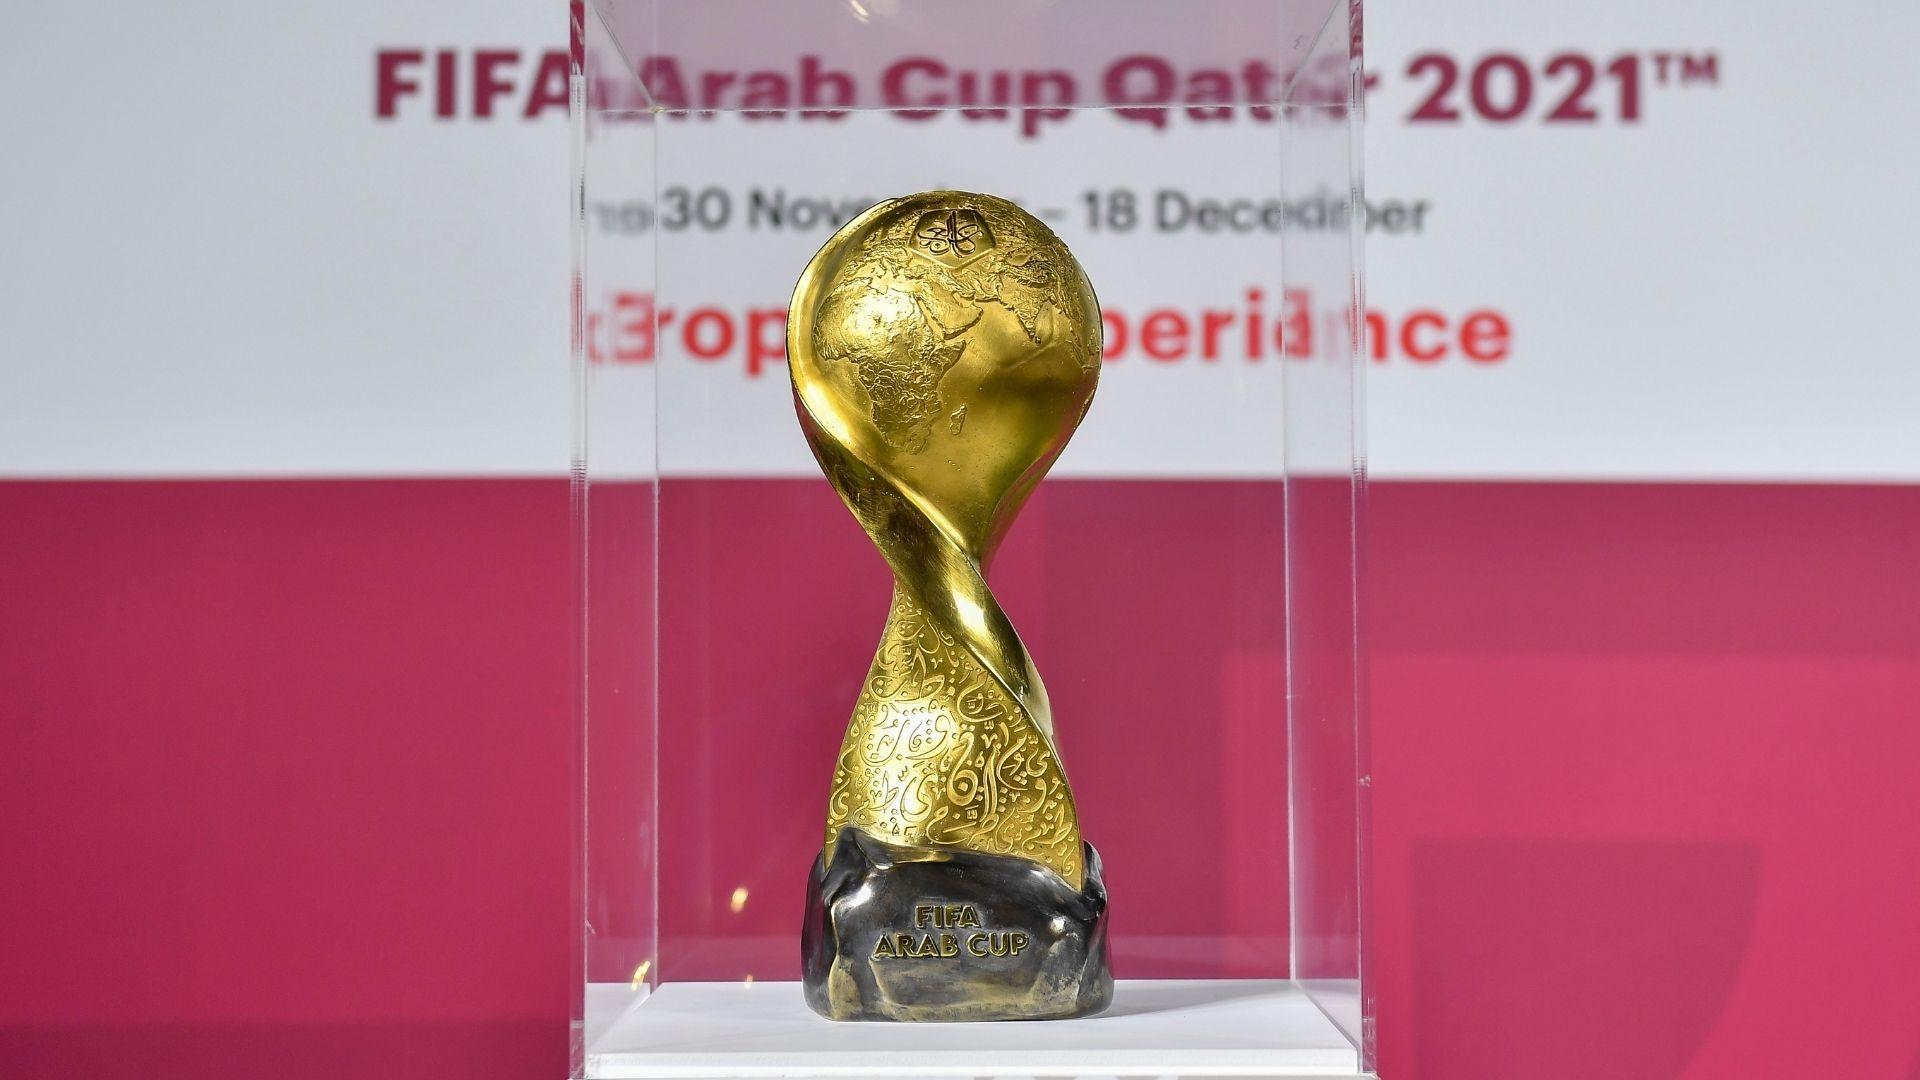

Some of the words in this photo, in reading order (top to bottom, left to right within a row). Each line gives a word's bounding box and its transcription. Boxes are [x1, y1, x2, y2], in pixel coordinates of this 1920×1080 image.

[375, 49, 571, 119] FIFA
[637, 54, 857, 121] Arab
[881, 55, 1078, 137] Cup
[661, 186, 731, 231] 30
[1083, 189, 1138, 233] 18
[915, 905, 982, 929] FIFA
[872, 933, 960, 958] ARAB
[966, 931, 1030, 957] CUP
